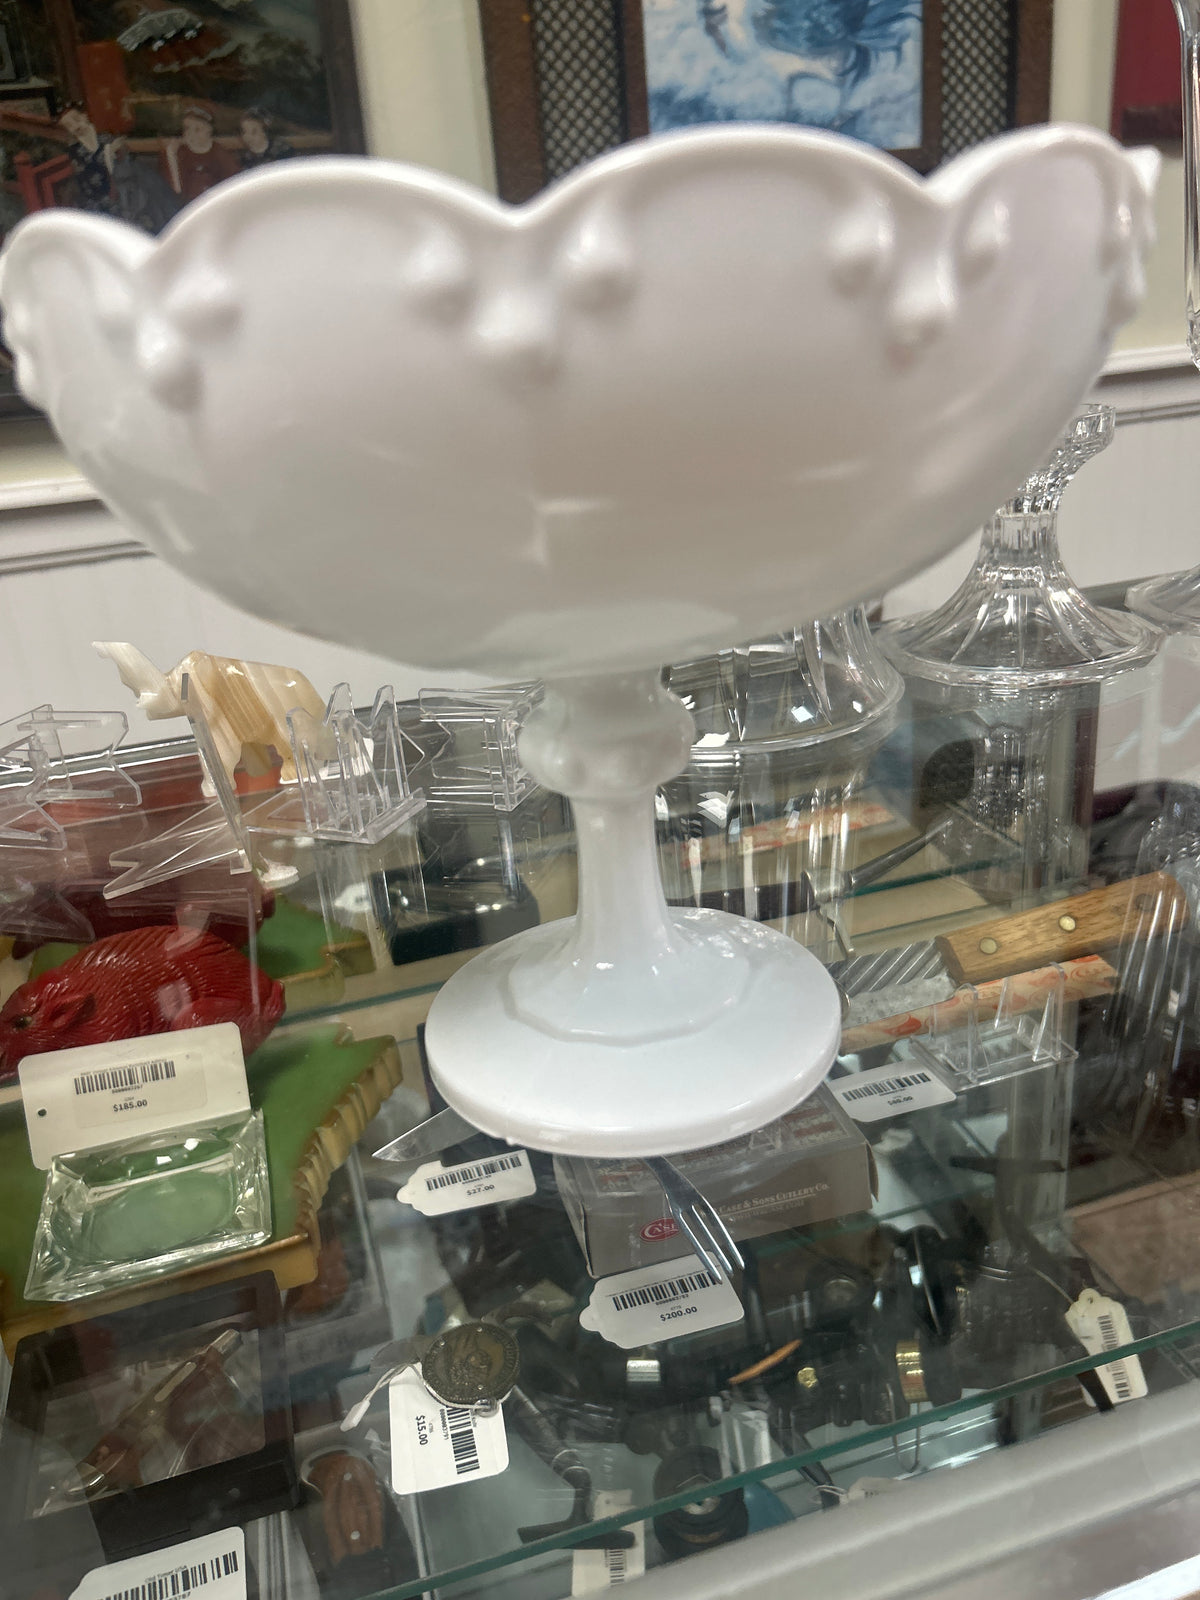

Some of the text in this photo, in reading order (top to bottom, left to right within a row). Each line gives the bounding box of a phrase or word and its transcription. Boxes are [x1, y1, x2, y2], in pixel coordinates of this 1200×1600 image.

[113, 1099, 148, 1112] $185.00
[466, 1184, 495, 1196] $27.00
[743, 1199, 751, 1209] &
[660, 1306, 698, 1321] $200.00
[415, 1414, 428, 1446] $15.00
